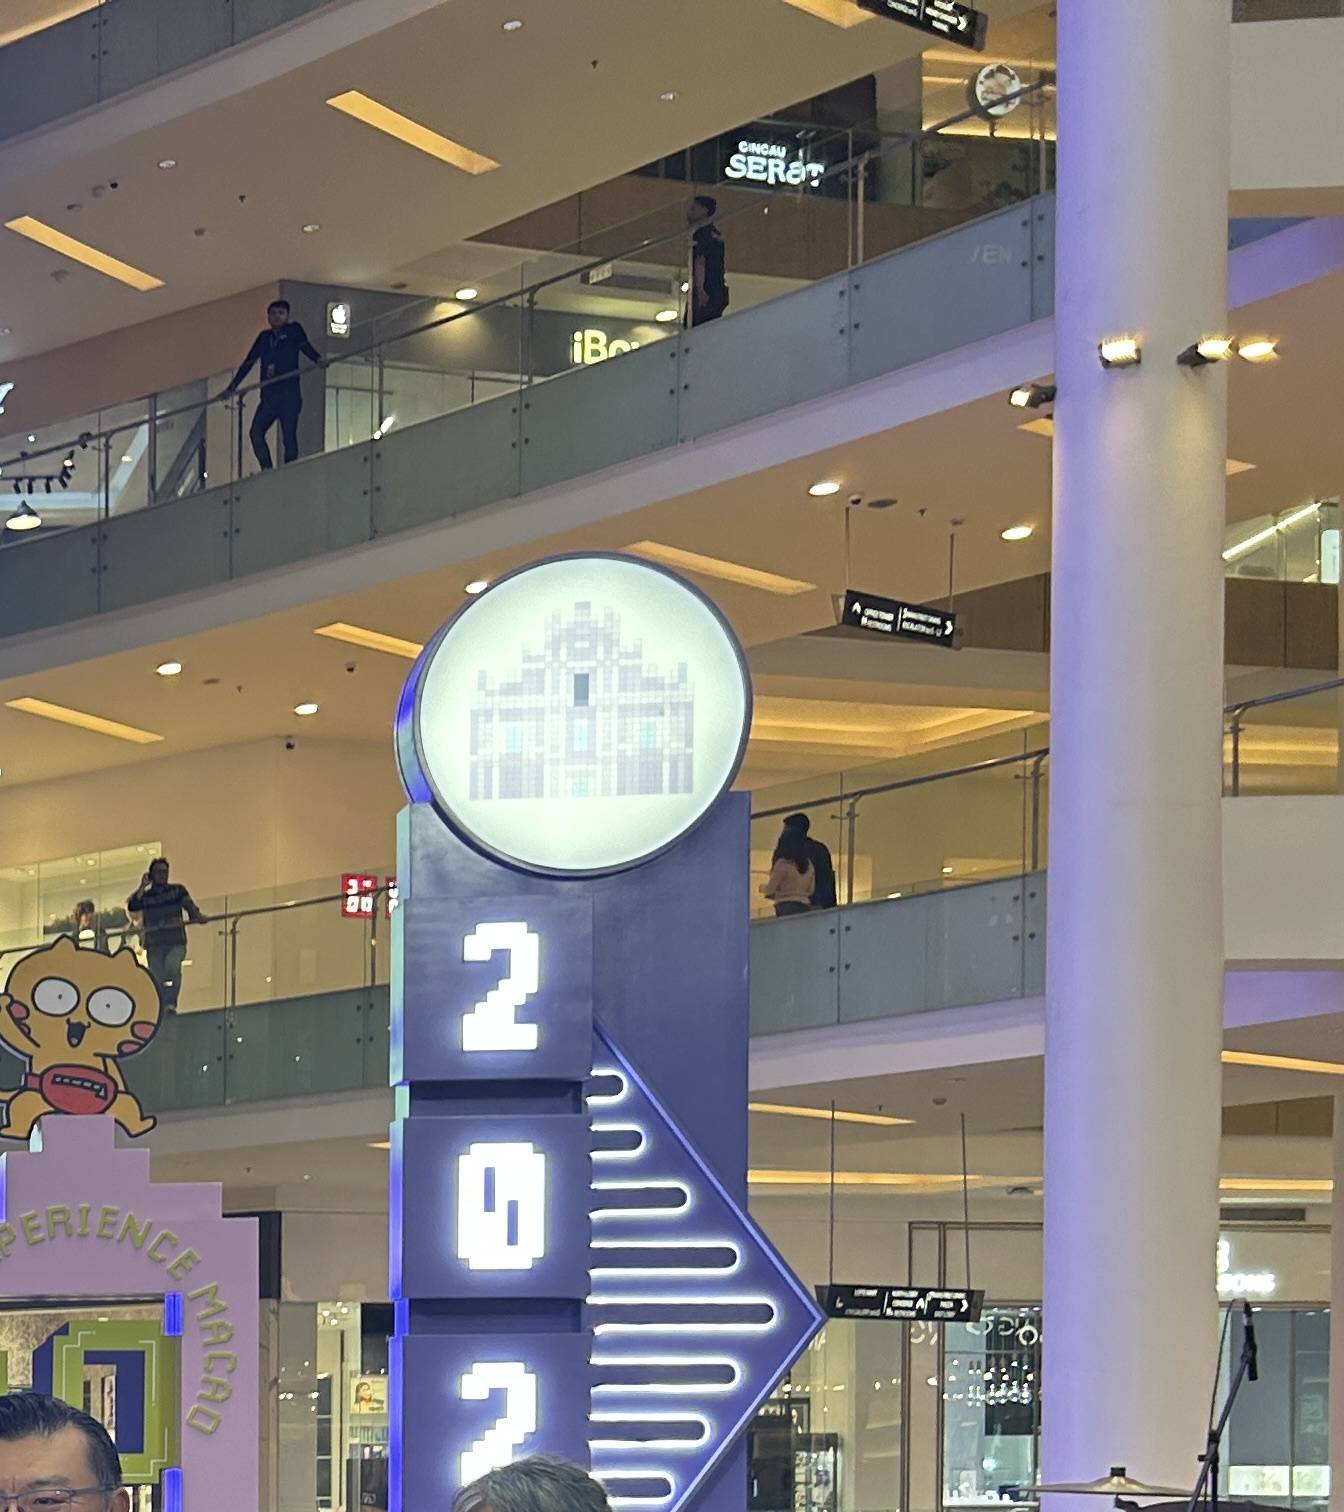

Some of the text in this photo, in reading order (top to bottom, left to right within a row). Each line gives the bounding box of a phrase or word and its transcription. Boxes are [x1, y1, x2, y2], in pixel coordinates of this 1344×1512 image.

[738, 141, 787, 158] CINCAU
[572, 329, 641, 365] iBo
[186, 1281, 238, 1435] MACAO
